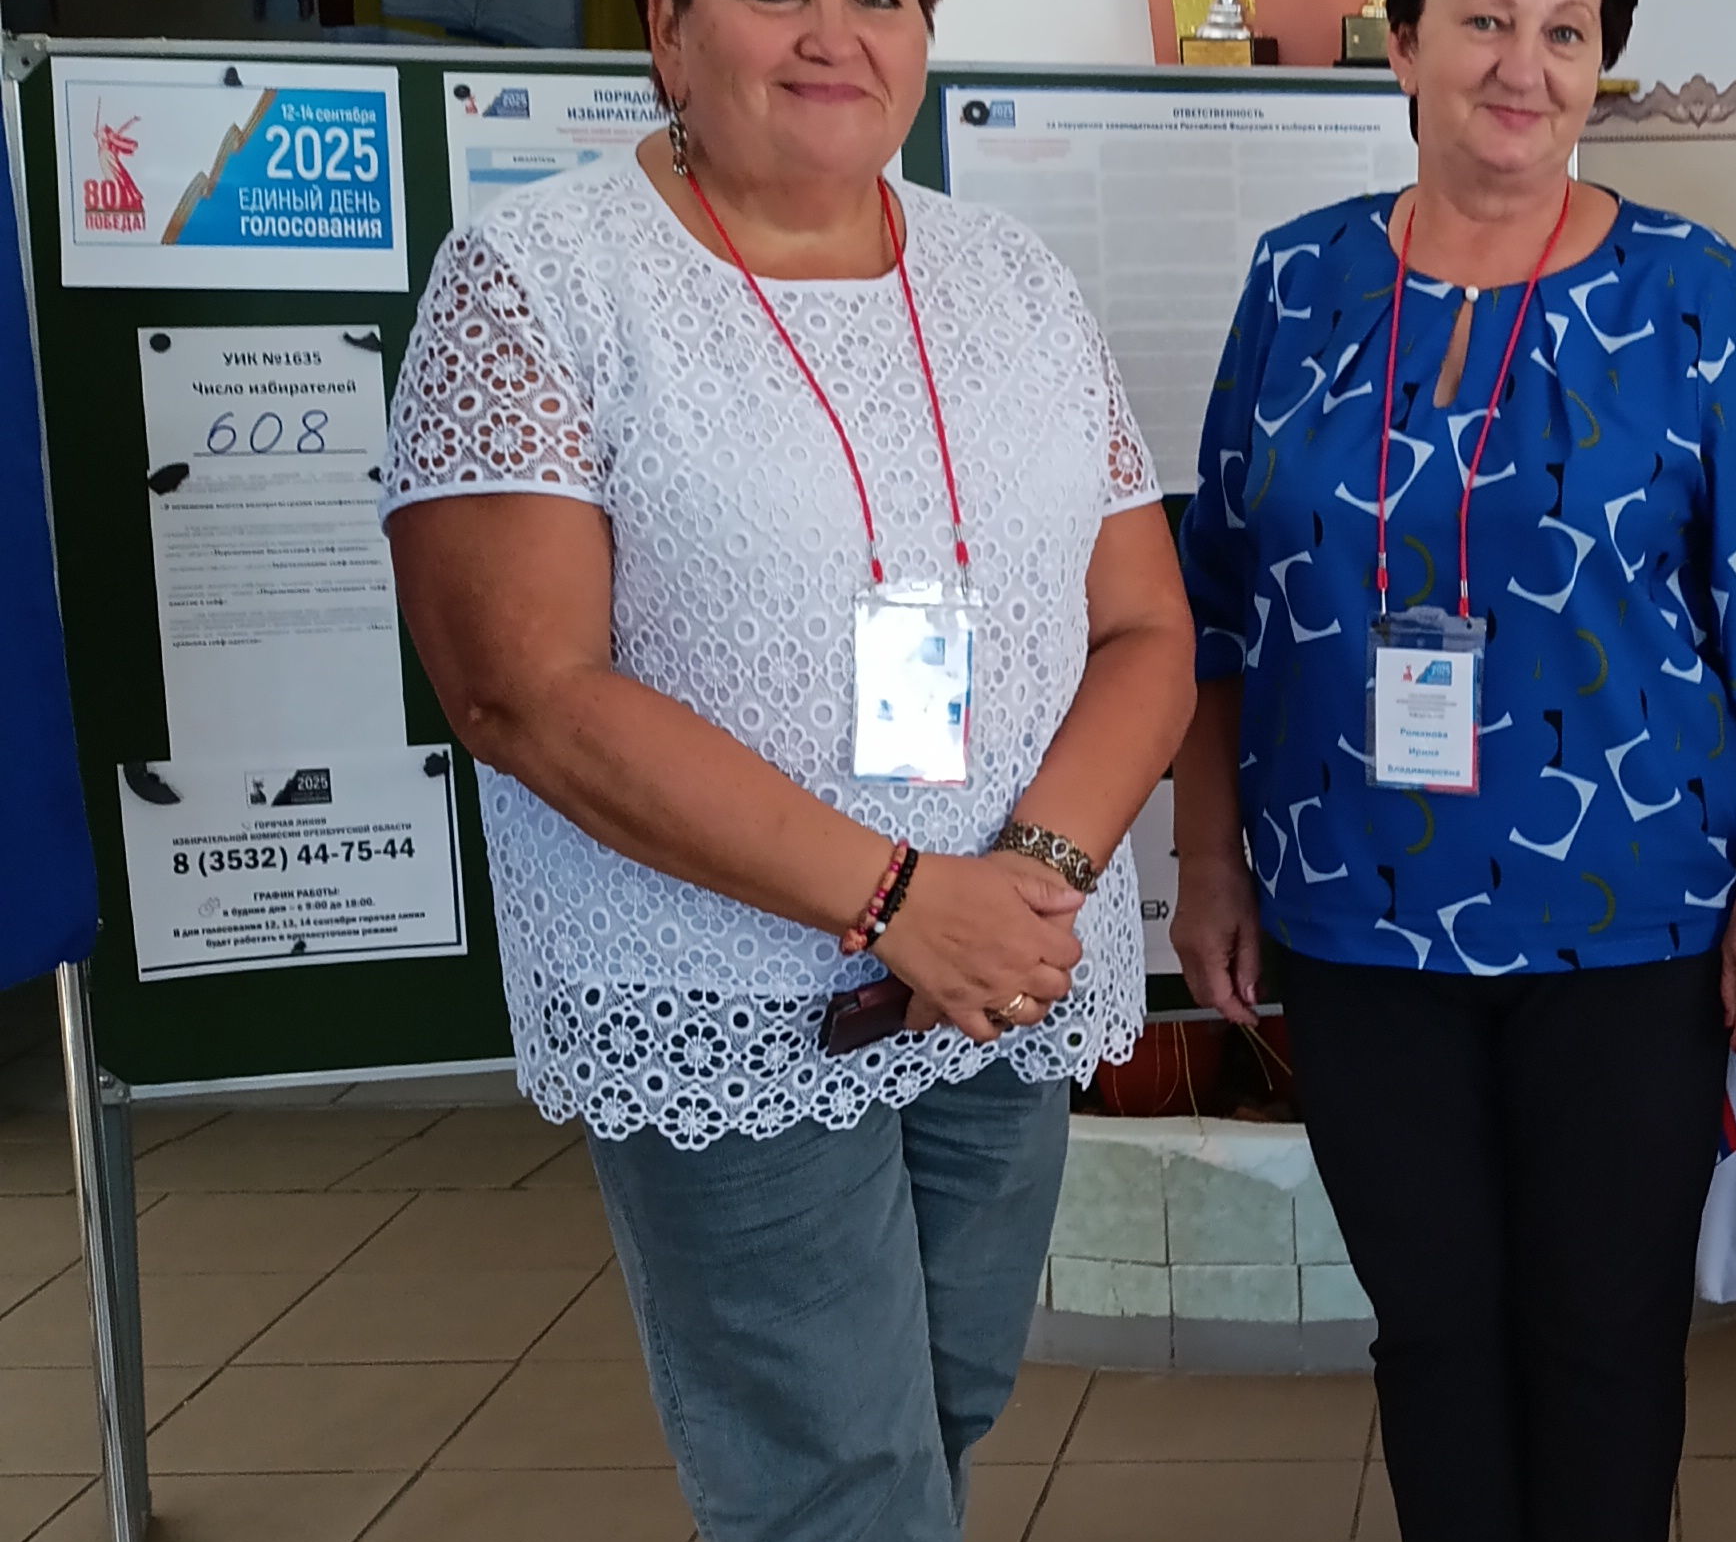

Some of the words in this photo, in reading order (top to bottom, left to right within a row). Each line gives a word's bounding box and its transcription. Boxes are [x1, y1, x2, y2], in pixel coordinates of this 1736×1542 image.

[281, 103, 314, 122] 12-14
[315, 106, 377, 125] сентября
[1172, 108, 1264, 119] ОТВЕТСТВЕННОСТЬ
[265, 124, 380, 182] 2025
[84, 178, 118, 209] 80
[239, 184, 323, 214] ЕДИНЫЙ
[329, 189, 382, 216] ДЕНЬ
[222, 351, 258, 367] УИК
[262, 351, 323, 367] №1635
[192, 381, 244, 396] Число
[249, 379, 357, 397] избирателей
[207, 409, 329, 455] 608
[297, 777, 329, 791] 2025
[172, 832, 249, 846] ИЗБИРАТЕЛЬНОЙ
[250, 830, 301, 841] КОМИССИИ
[303, 824, 370, 838] ОРЕНБУРГСКОЙ
[373, 822, 412, 833] ОБЛАСТИ
[254, 819, 294, 830] ГОРЯЧАЯ
[173, 851, 190, 875] 8
[198, 846, 289, 878] (3532)
[297, 837, 416, 867] 44-75-44
[253, 890, 294, 902] ГРАФИК
[202, 922, 262, 935] голосования
[313, 915, 357, 927] сентября
[206, 937, 232, 948] будет
[233, 934, 277, 947] работать
[362, 925, 398, 938] режиме
